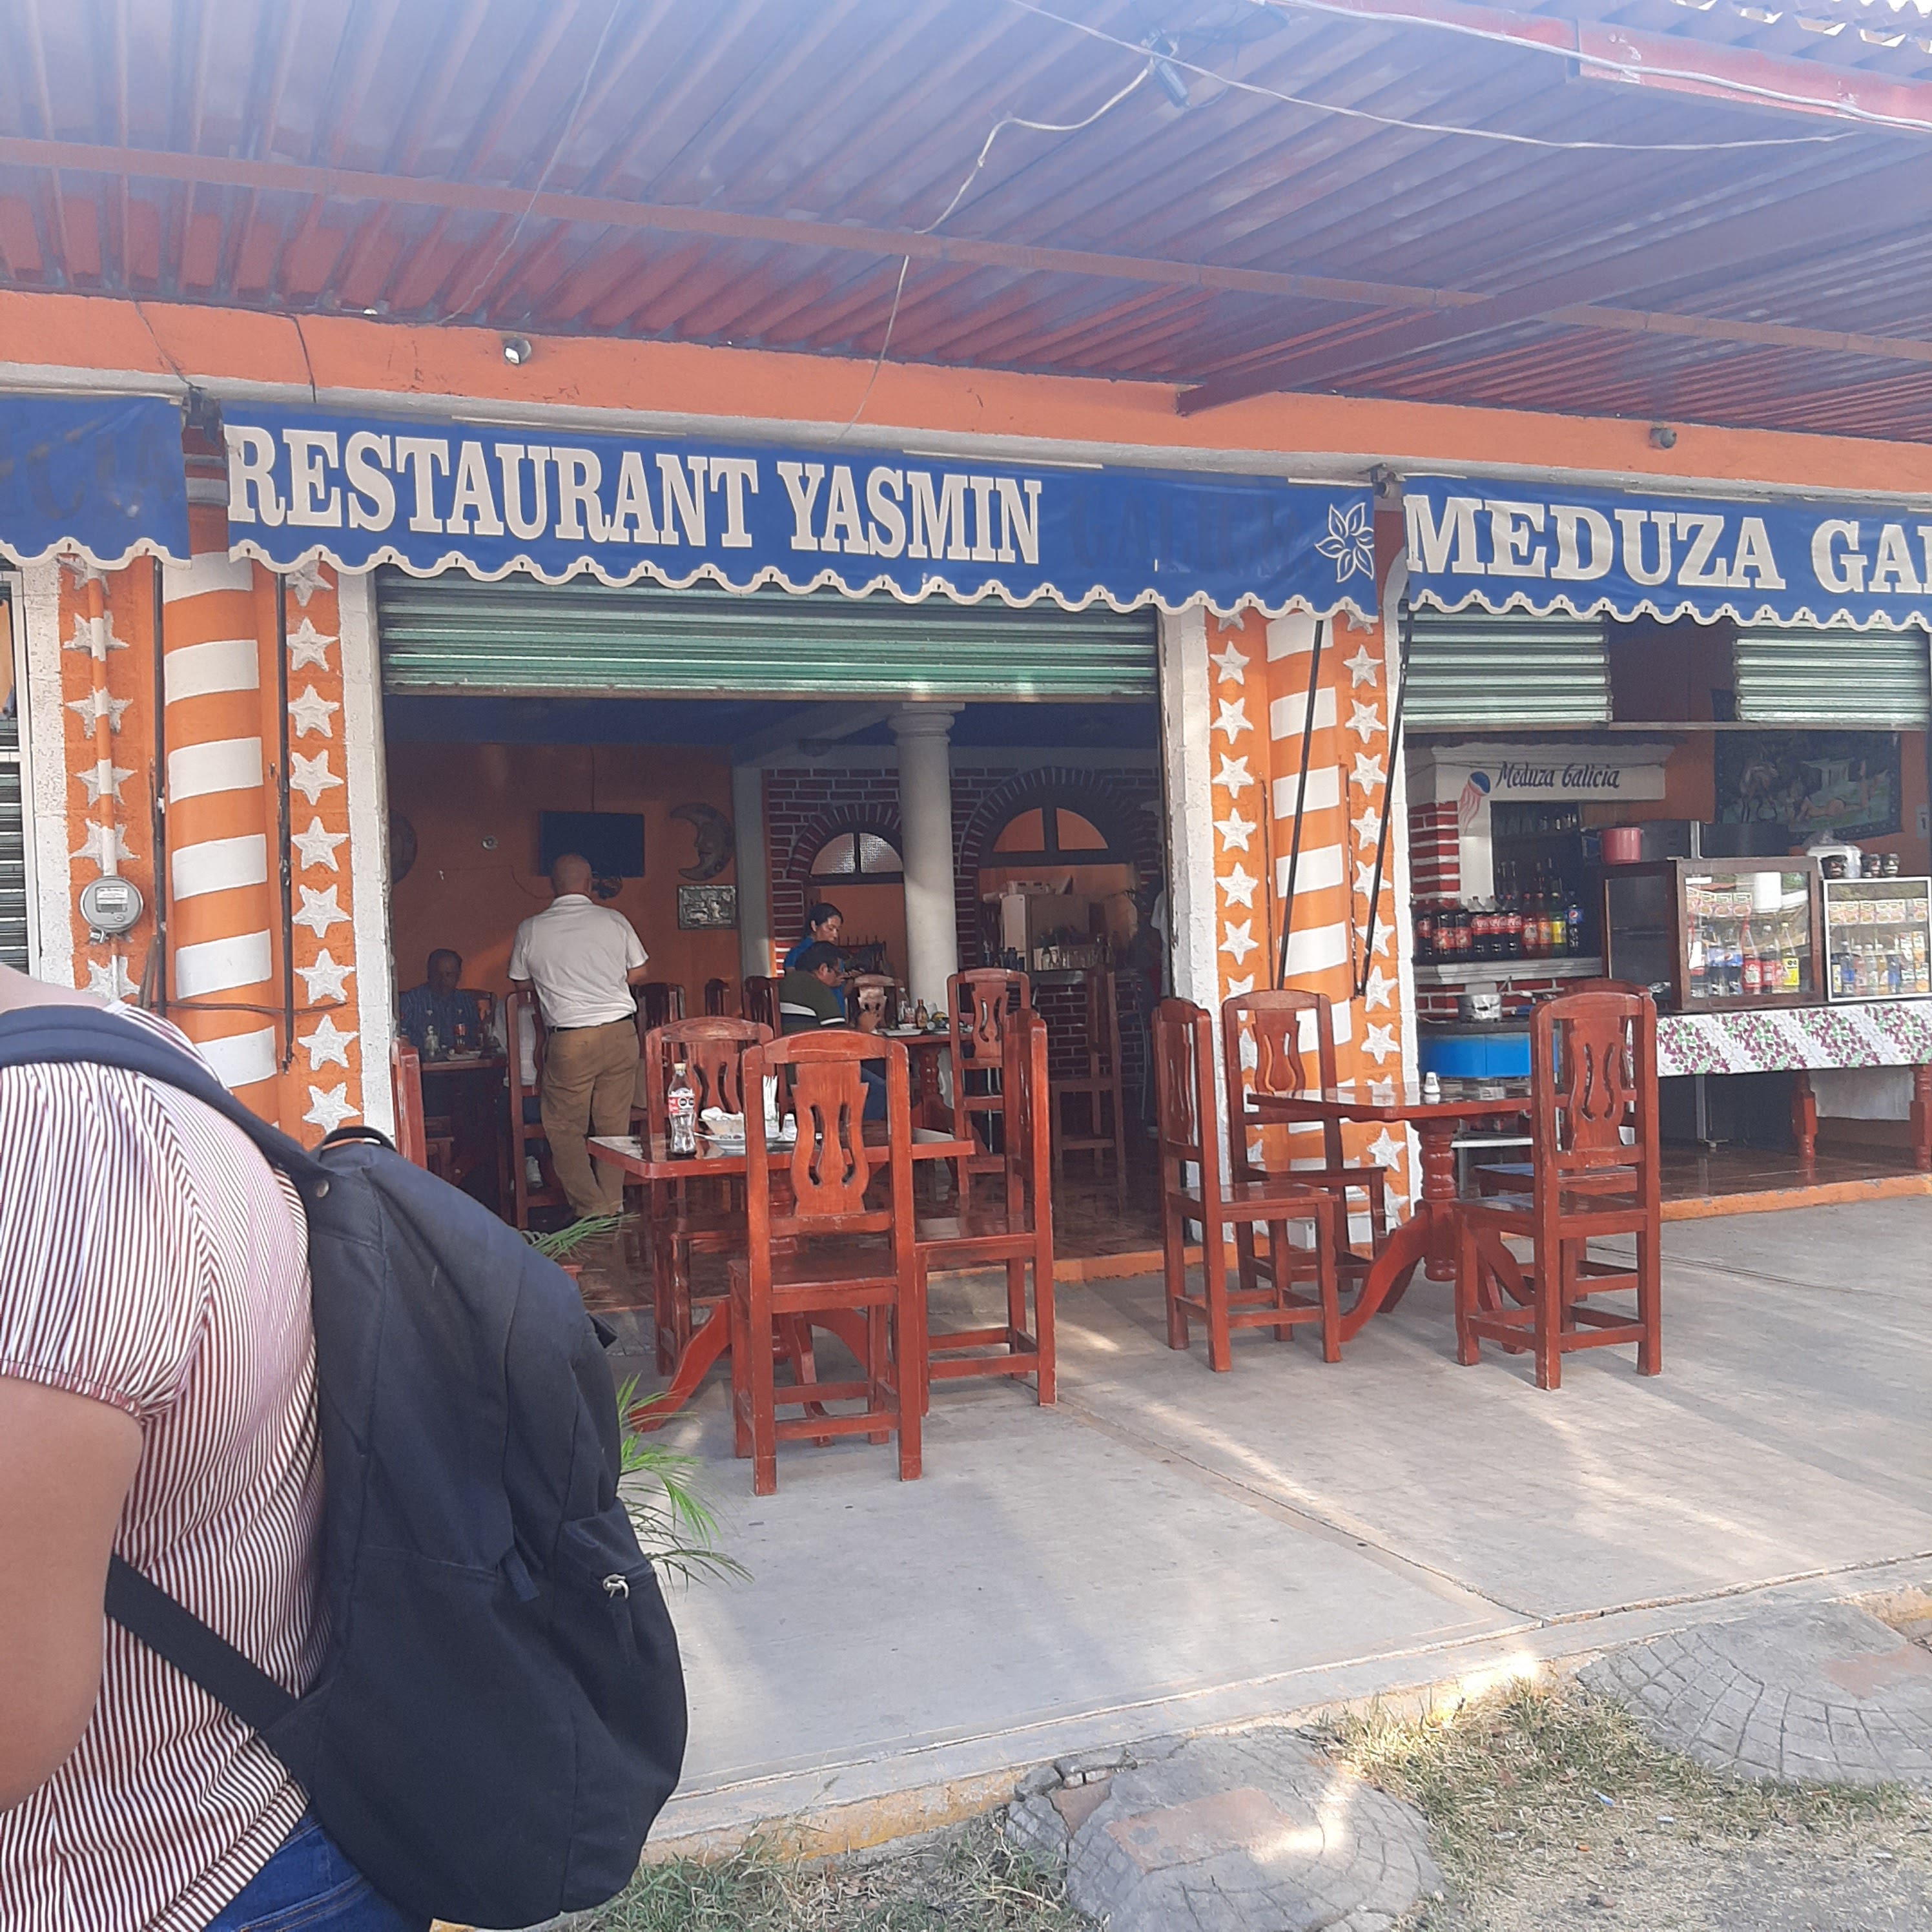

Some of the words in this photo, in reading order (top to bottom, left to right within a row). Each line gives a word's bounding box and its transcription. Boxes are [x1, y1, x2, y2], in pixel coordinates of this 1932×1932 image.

[223, 424, 759, 548] RESTAURANT
[777, 461, 1042, 564] YASMIN
[1403, 494, 1786, 590] MEDUZA
[1495, 761, 1556, 788] Meduza
[1561, 762, 1621, 788] Galicia
